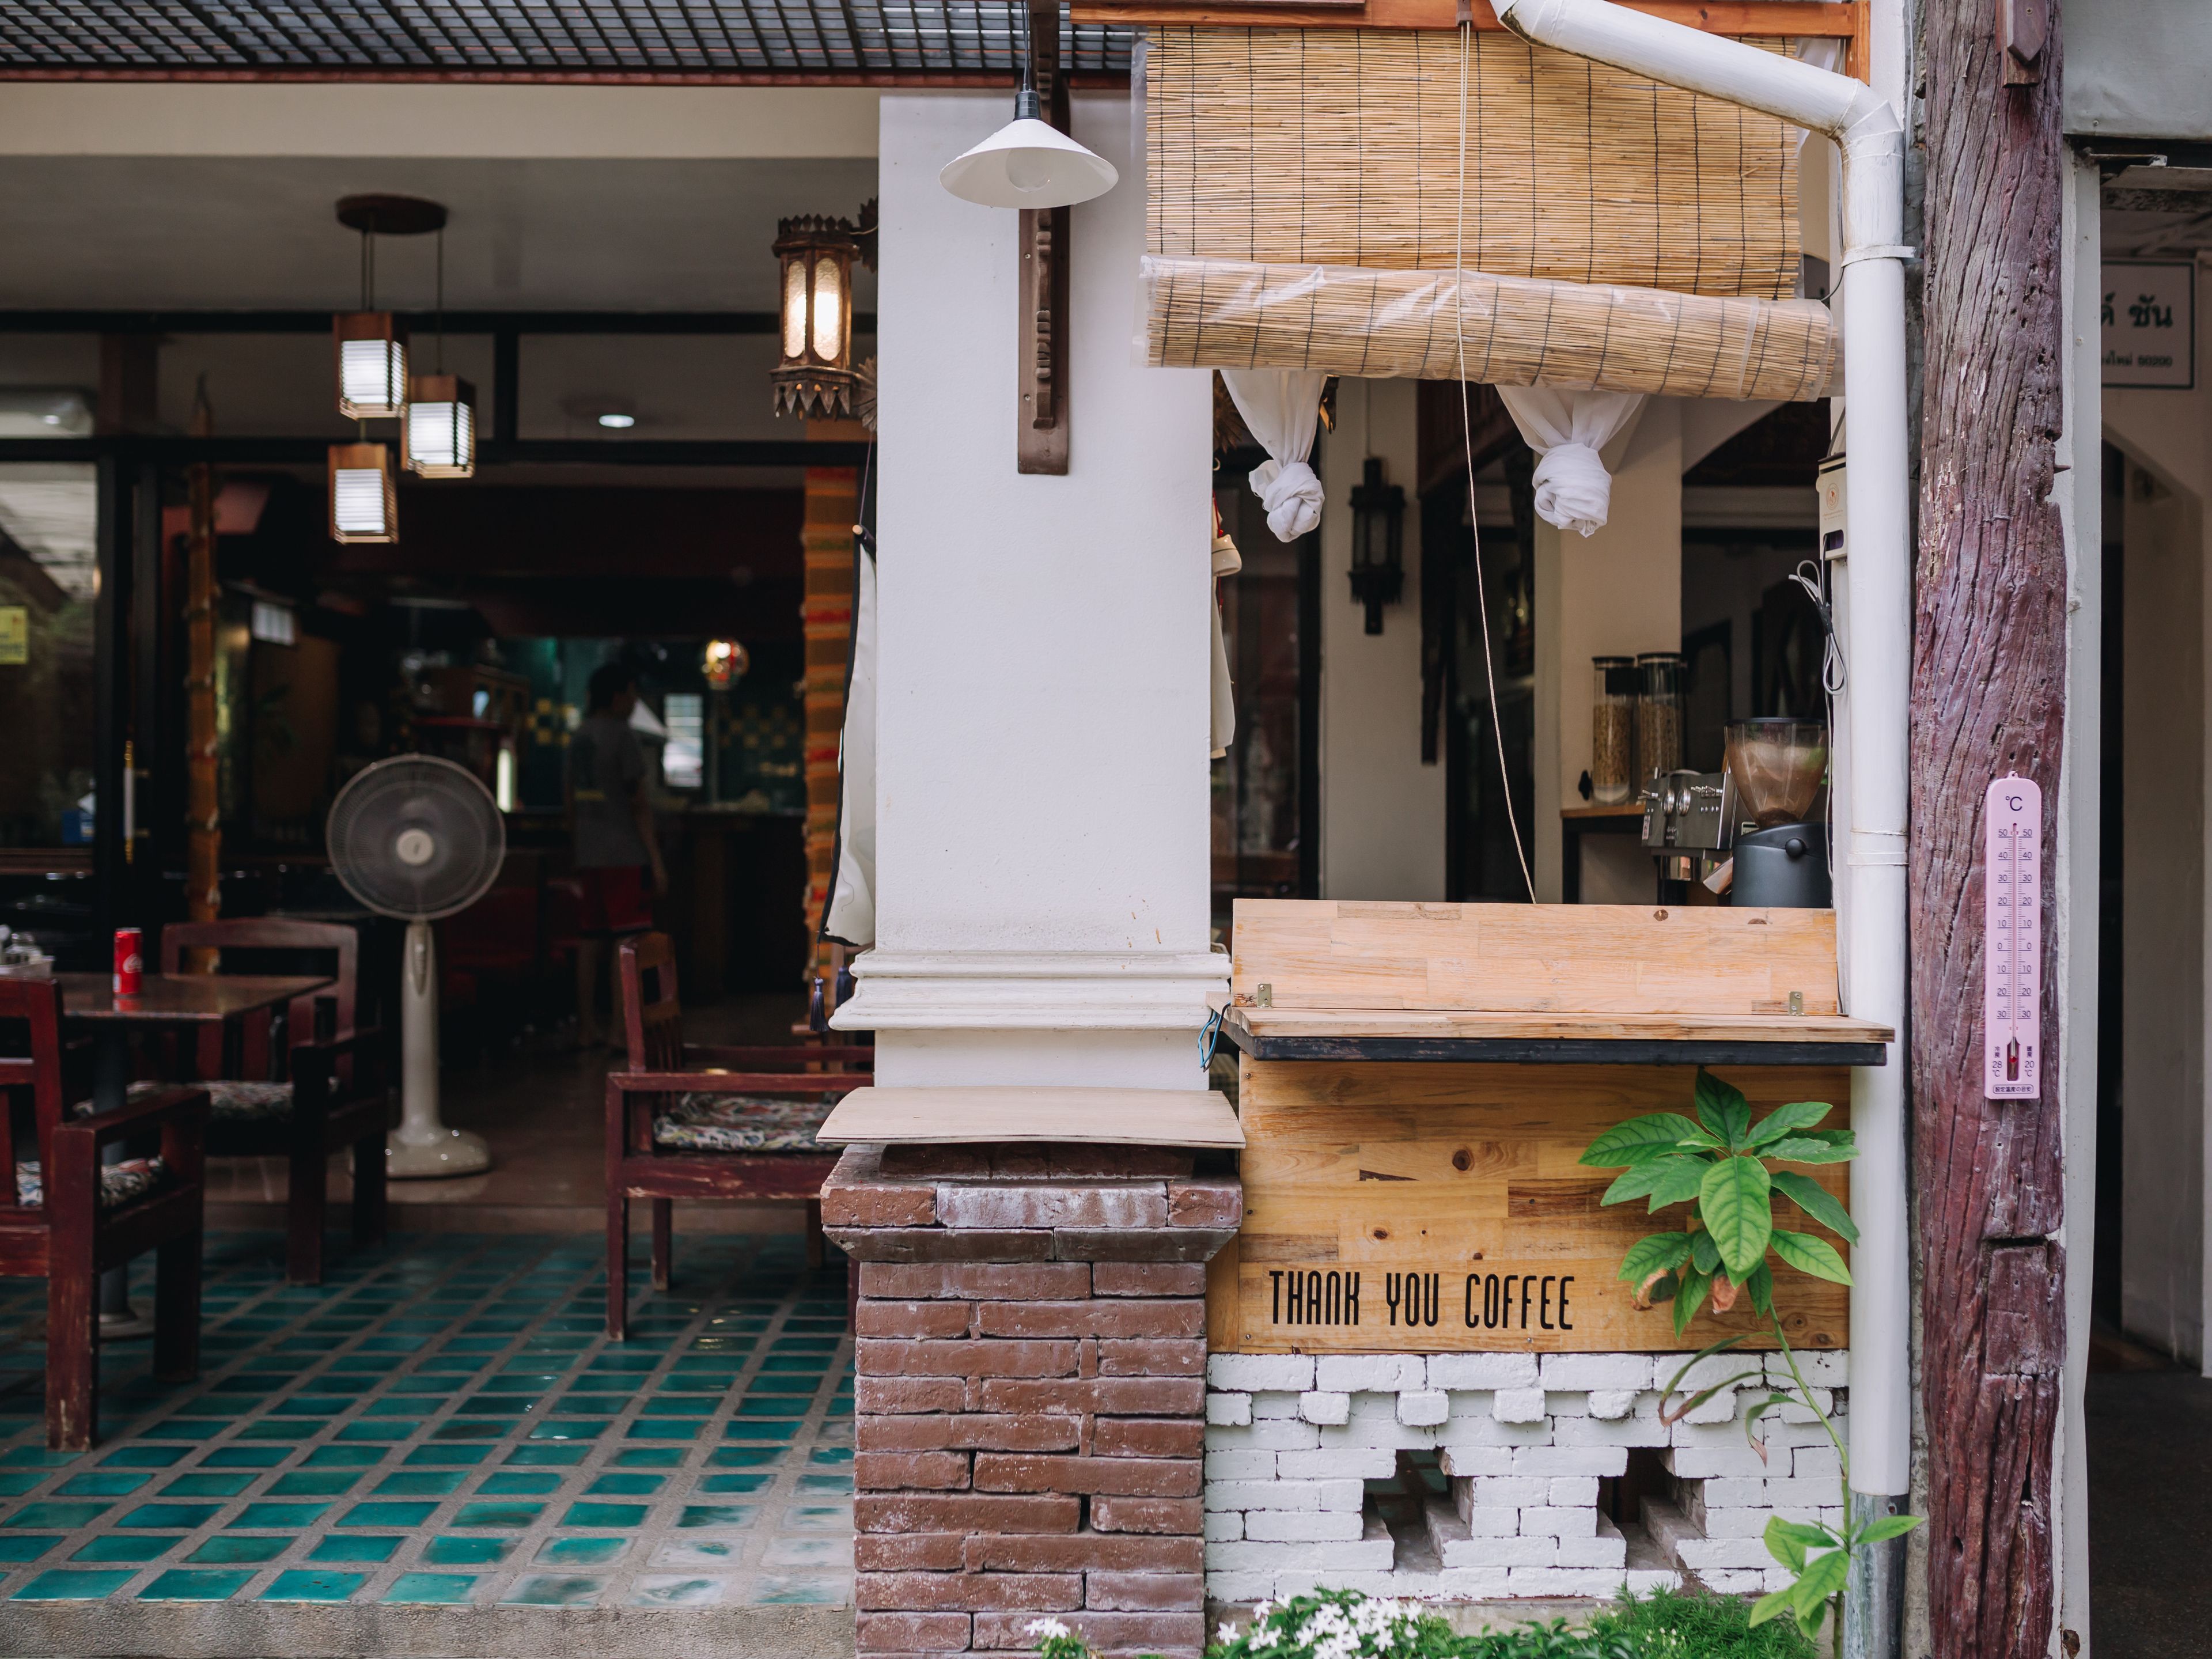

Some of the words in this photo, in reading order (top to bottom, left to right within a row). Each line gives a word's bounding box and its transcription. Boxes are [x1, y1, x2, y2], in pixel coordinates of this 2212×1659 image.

[2005, 796, 2022, 811] °C
[1993, 1060, 2002, 1069] 28
[2025, 1060, 2035, 1069] 20
[1268, 1270, 1360, 1325] THANK
[1386, 1272, 1439, 1327] YOU
[1464, 1273, 1575, 1330] COFFEE
